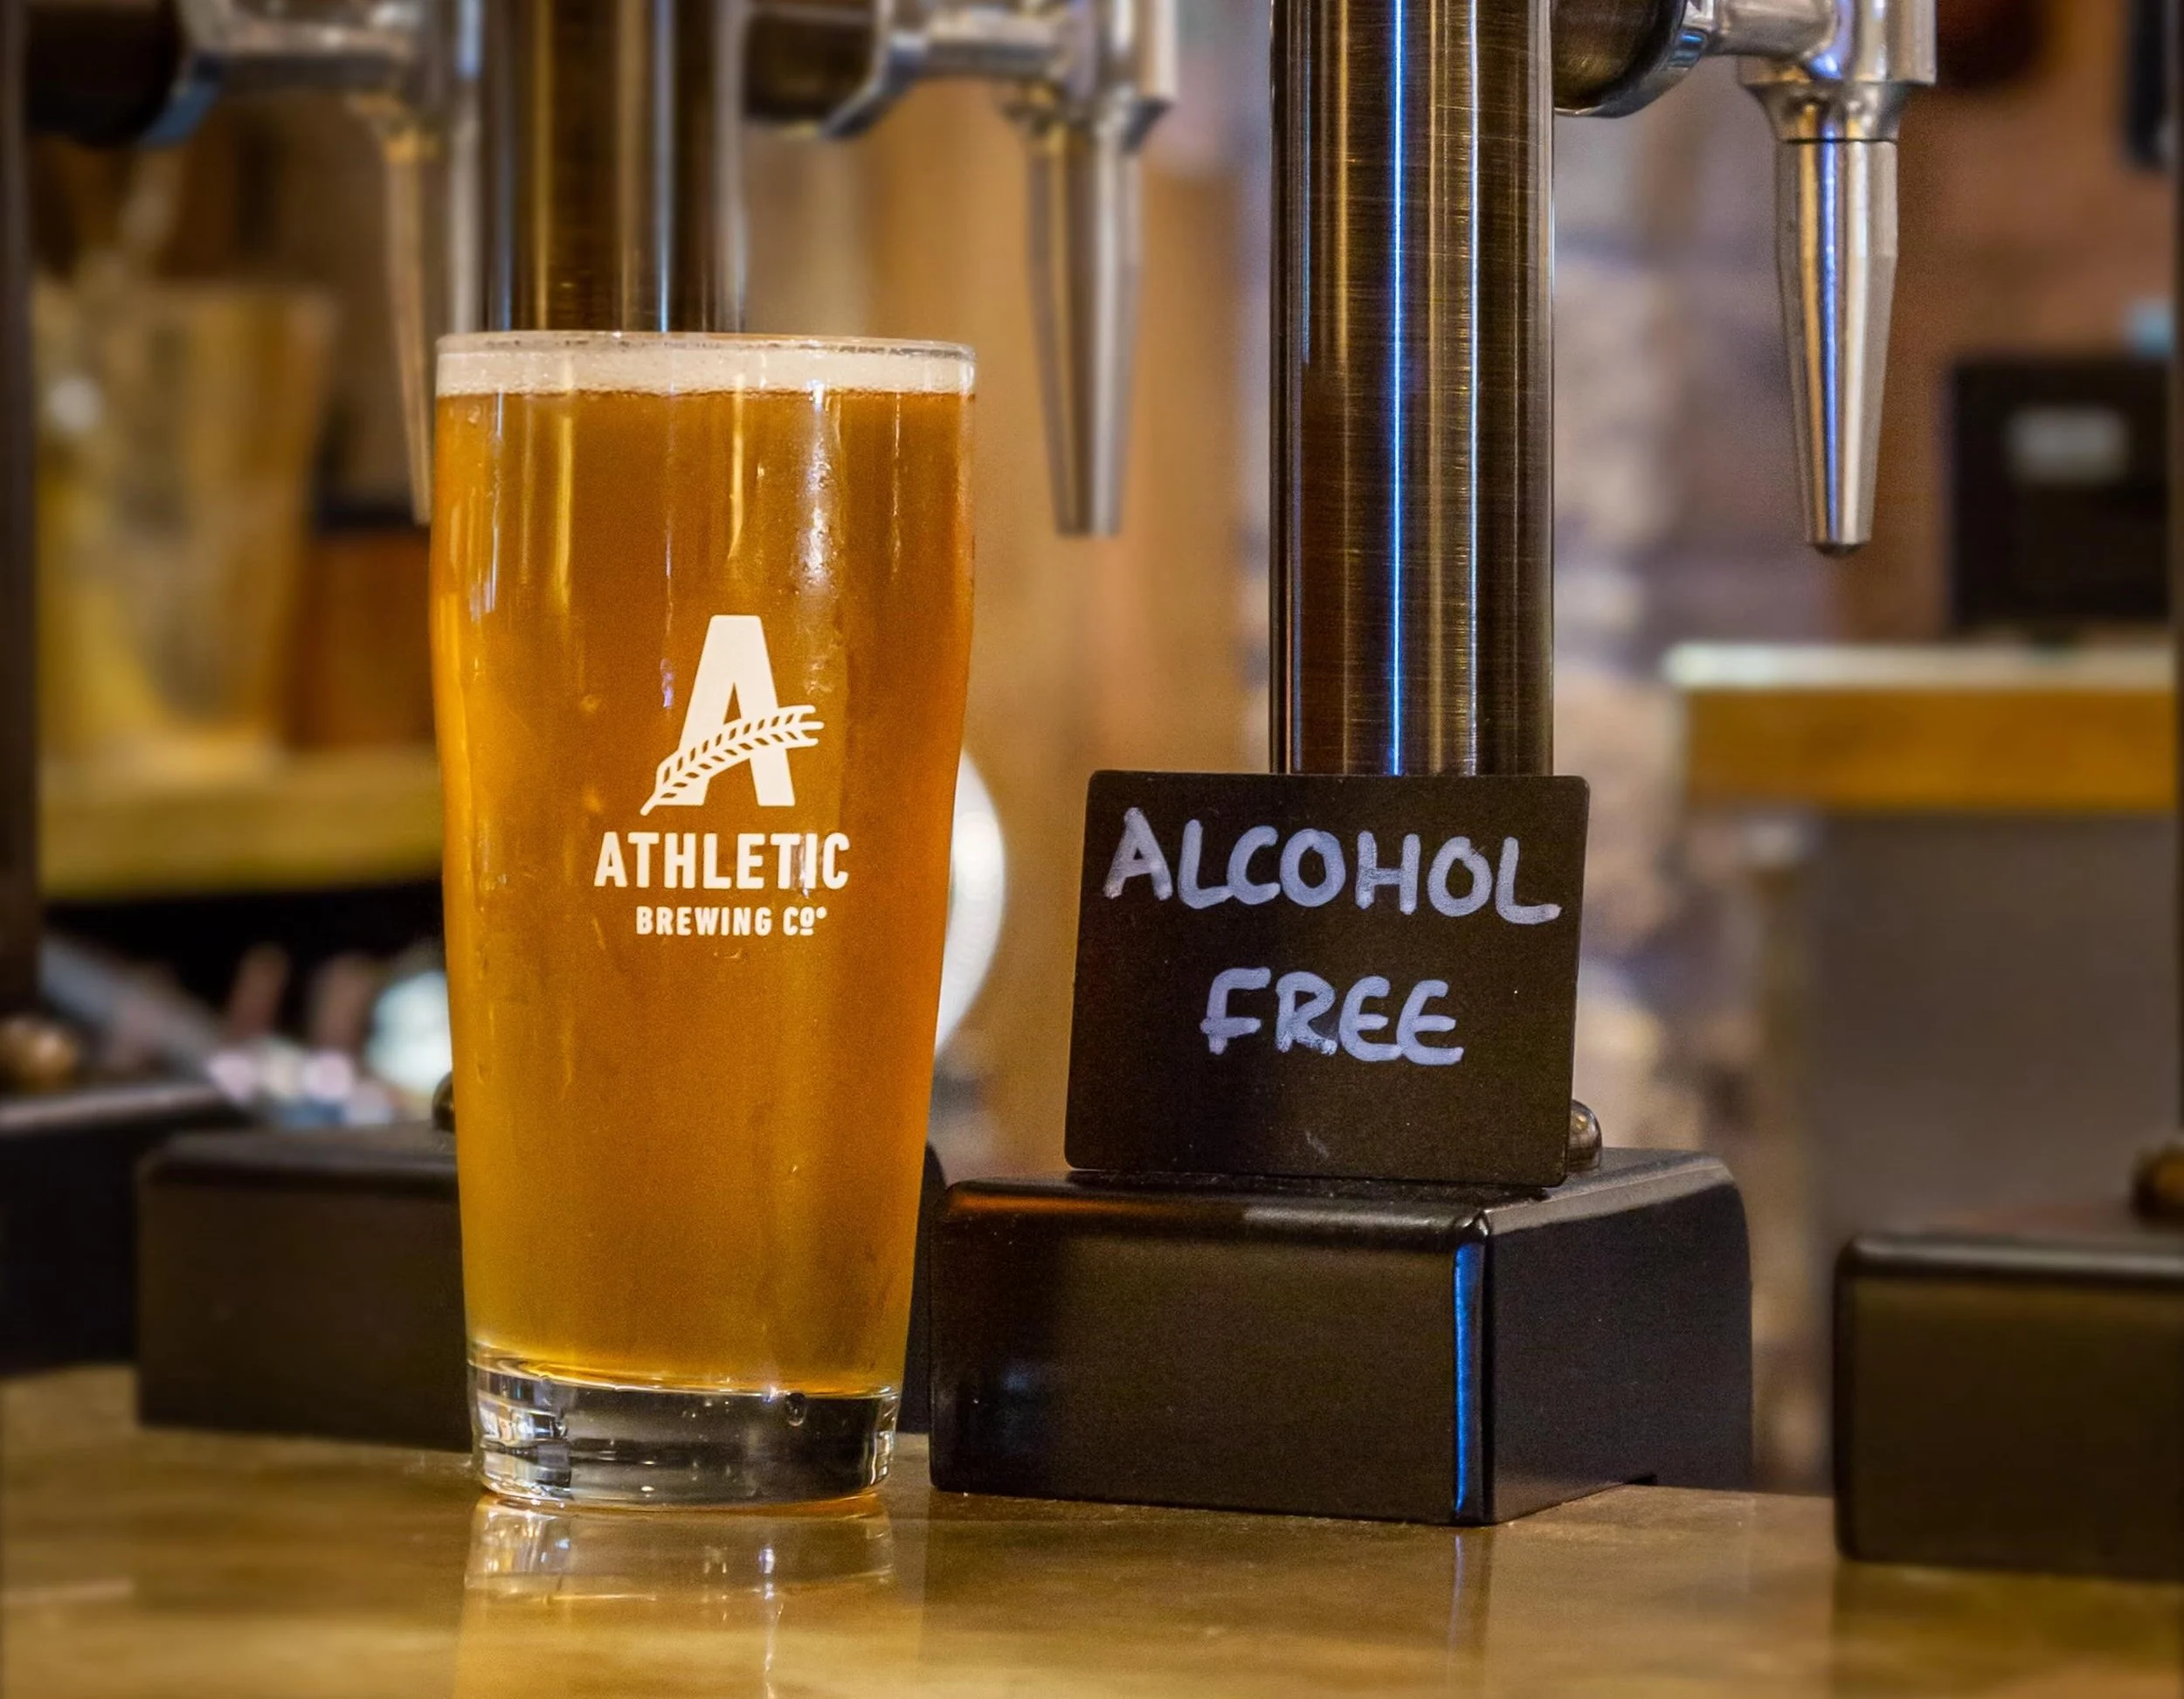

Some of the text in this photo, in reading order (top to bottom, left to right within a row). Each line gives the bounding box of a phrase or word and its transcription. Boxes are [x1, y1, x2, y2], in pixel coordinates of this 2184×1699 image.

[653, 615, 796, 807] A
[593, 831, 851, 890] ATHLETIC
[1103, 806, 1562, 925] ALCOHOL
[635, 905, 772, 936] BREWING
[1199, 966, 1464, 1066] FREE
